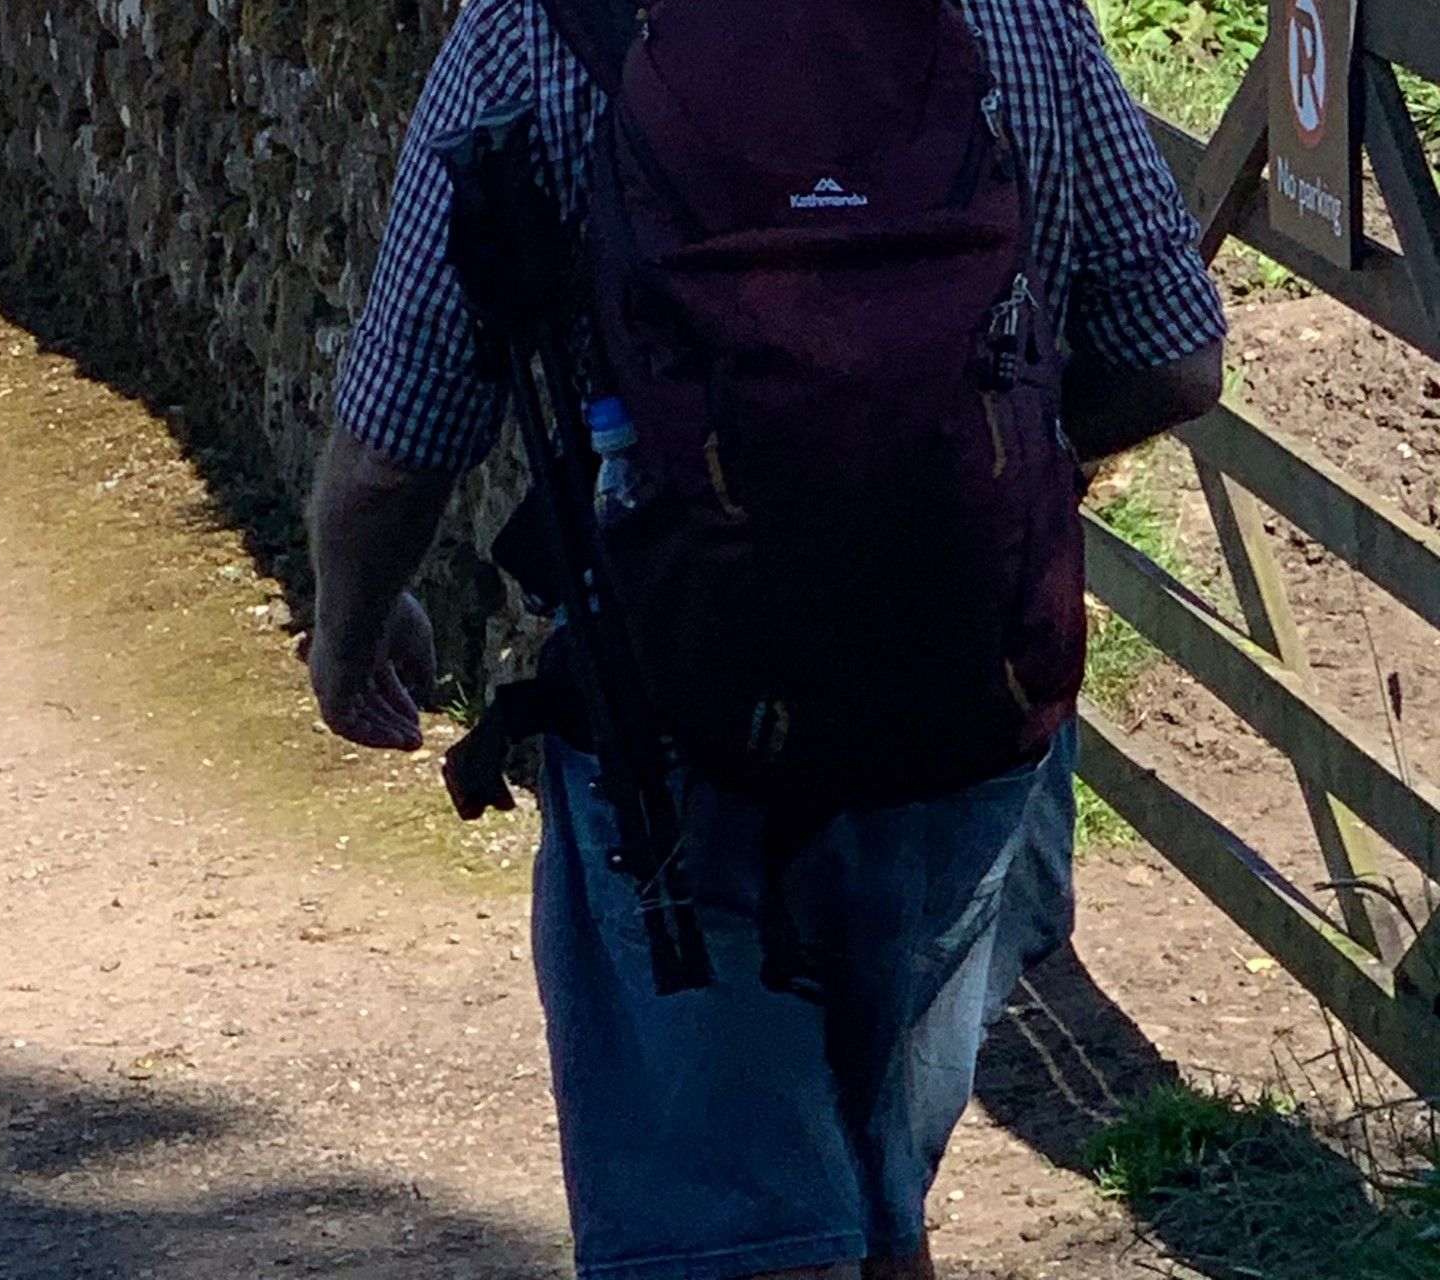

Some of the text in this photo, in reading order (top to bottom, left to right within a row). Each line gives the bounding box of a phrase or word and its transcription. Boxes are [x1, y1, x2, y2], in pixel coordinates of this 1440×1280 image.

[789, 192, 868, 208] Kathmandu
[1276, 154, 1342, 237] No parking
